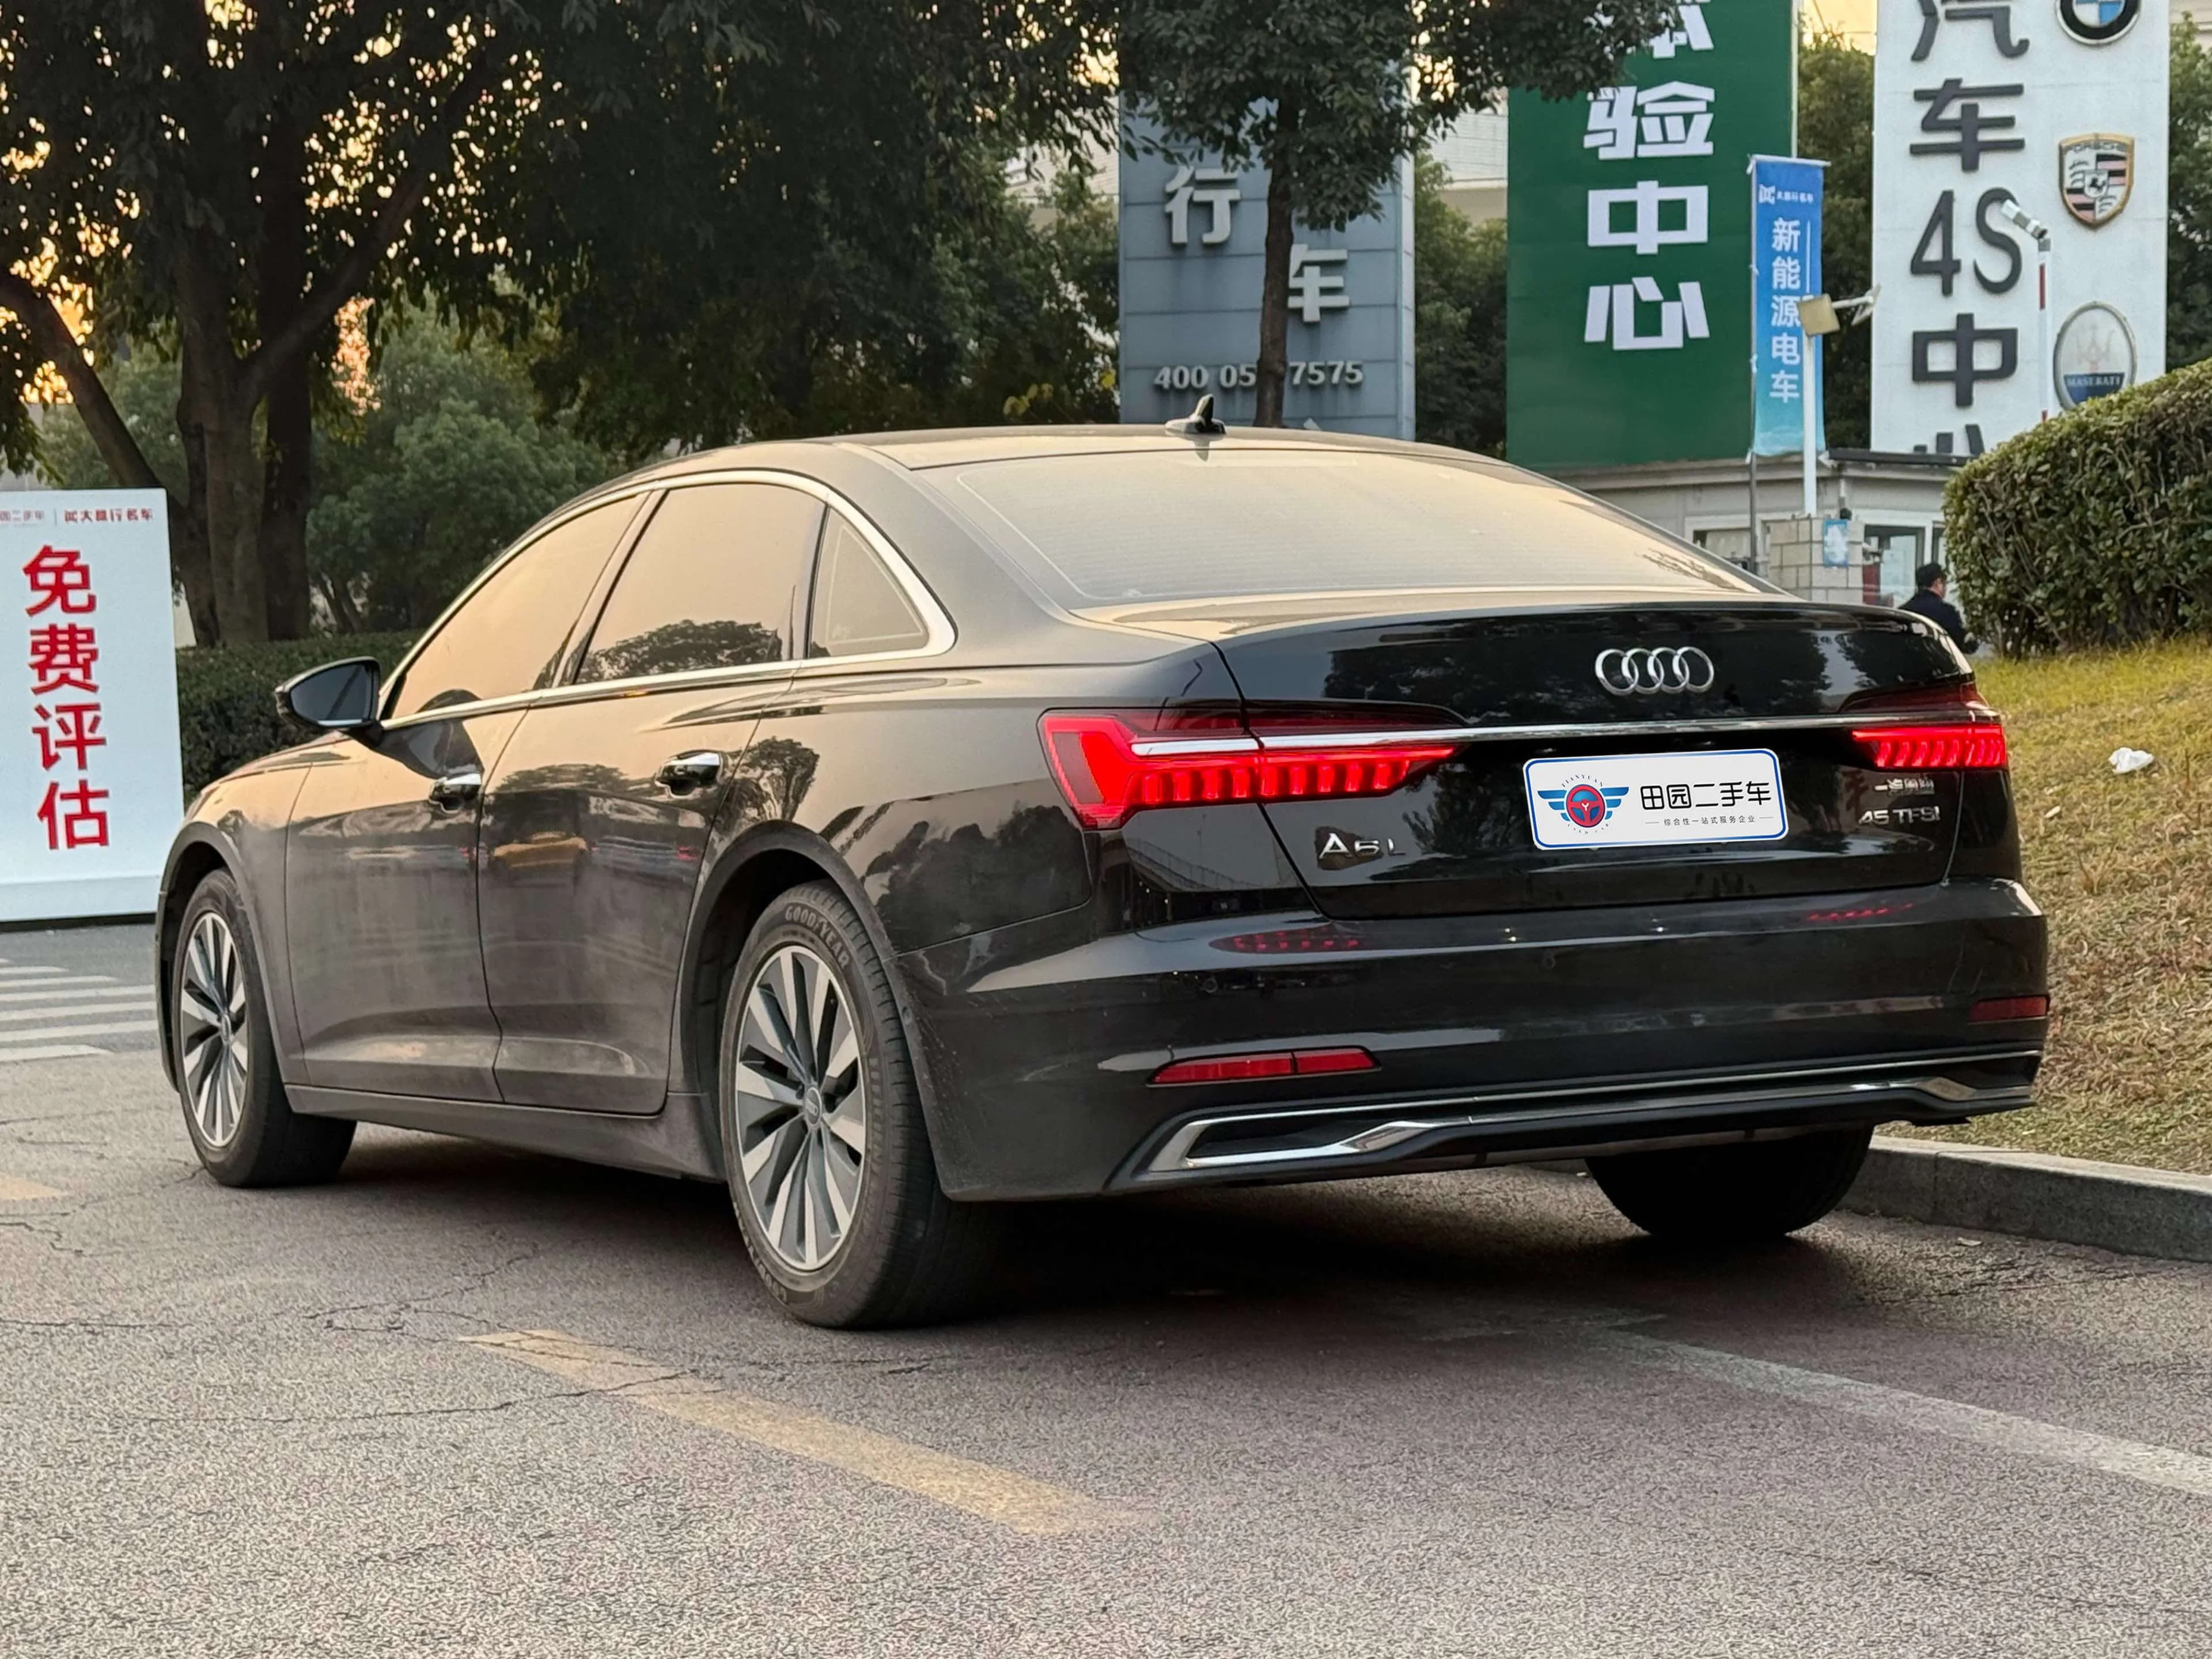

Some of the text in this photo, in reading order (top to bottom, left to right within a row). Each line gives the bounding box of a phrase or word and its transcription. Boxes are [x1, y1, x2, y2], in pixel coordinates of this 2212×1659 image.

[1165, 165, 1241, 244] 行
[1910, 0, 2030, 454] 汽车4S中
[1770, 217, 1801, 403] 新能源电车
[1154, 361, 1364, 389] 400 05 7575
[22, 545, 109, 850] 免费评估
[1859, 806, 1941, 825] 45 TFSI
[785, 906, 850, 970] GOODYEAR
